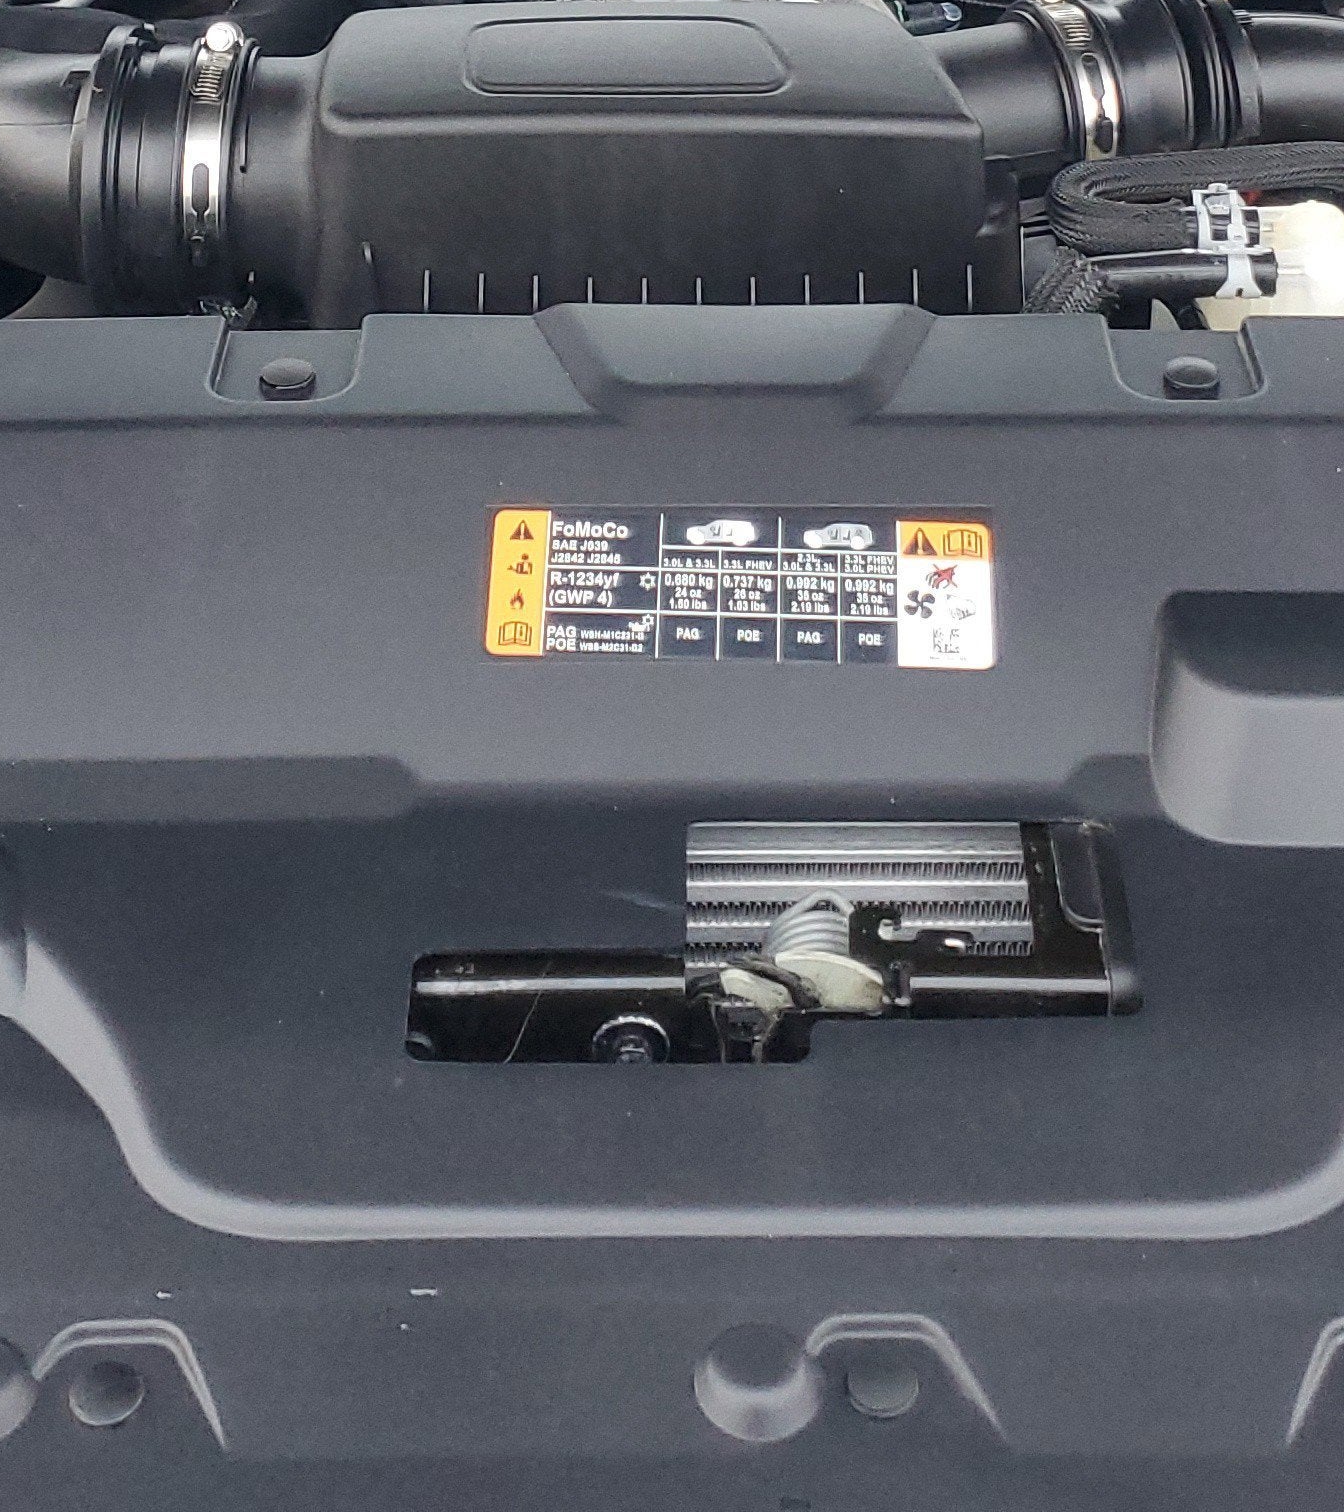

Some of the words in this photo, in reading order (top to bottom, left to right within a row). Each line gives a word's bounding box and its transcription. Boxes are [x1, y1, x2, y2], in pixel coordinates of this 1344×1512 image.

[552, 521, 629, 538] FoMoCo
[552, 539, 577, 550] SAE
[663, 558, 683, 568] 3.0L
[696, 559, 716, 569] 3.3L
[723, 559, 743, 569] 3.3L
[550, 571, 619, 589] R-1234yf
[698, 574, 713, 590] kg
[723, 575, 754, 588] 0.737
[757, 576, 772, 592] kg
[820, 577, 835, 594] kg
[675, 587, 687, 598] 24
[879, 579, 895, 596] kg
[549, 589, 595, 606] (GWP
[597, 590, 613, 607] 4)
[547, 625, 577, 639] PAG
[676, 627, 700, 640] PAG
[737, 629, 761, 642] POE
[797, 631, 821, 644] PAG
[546, 638, 576, 651] POE
